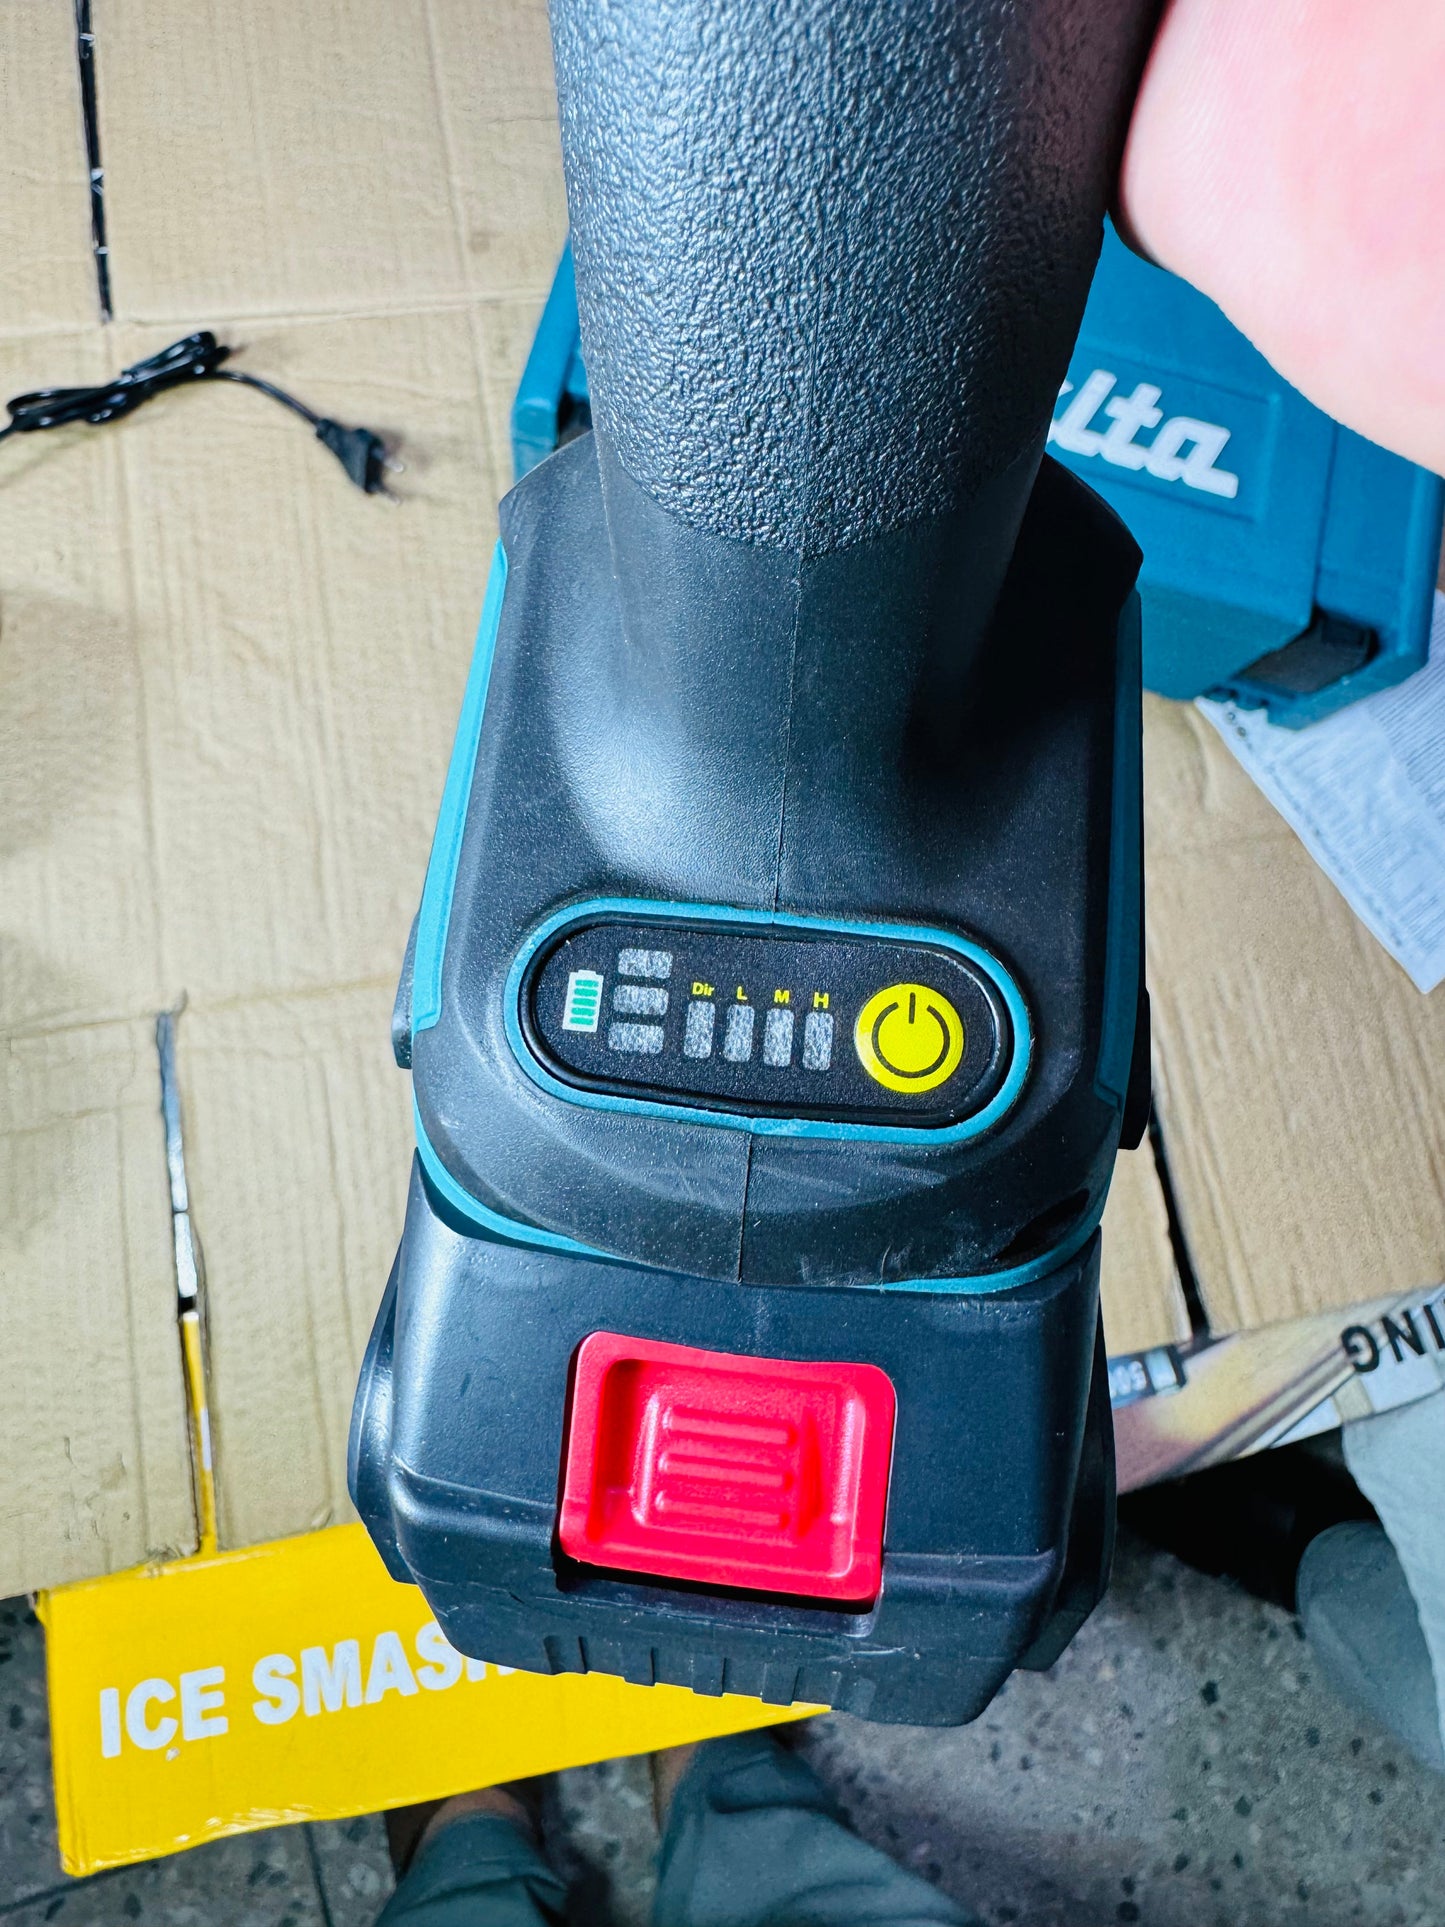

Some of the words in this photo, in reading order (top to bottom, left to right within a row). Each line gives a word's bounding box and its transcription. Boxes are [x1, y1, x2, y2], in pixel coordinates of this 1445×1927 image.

[1046, 369, 1239, 499] ita
[691, 981, 714, 997] Dir
[736, 985, 748, 1001] L
[773, 989, 790, 1004] M
[812, 991, 830, 1009] H
[1341, 1300, 1445, 1373] ING
[100, 1666, 229, 1758] ICE
[251, 1621, 515, 1726] SMAS
